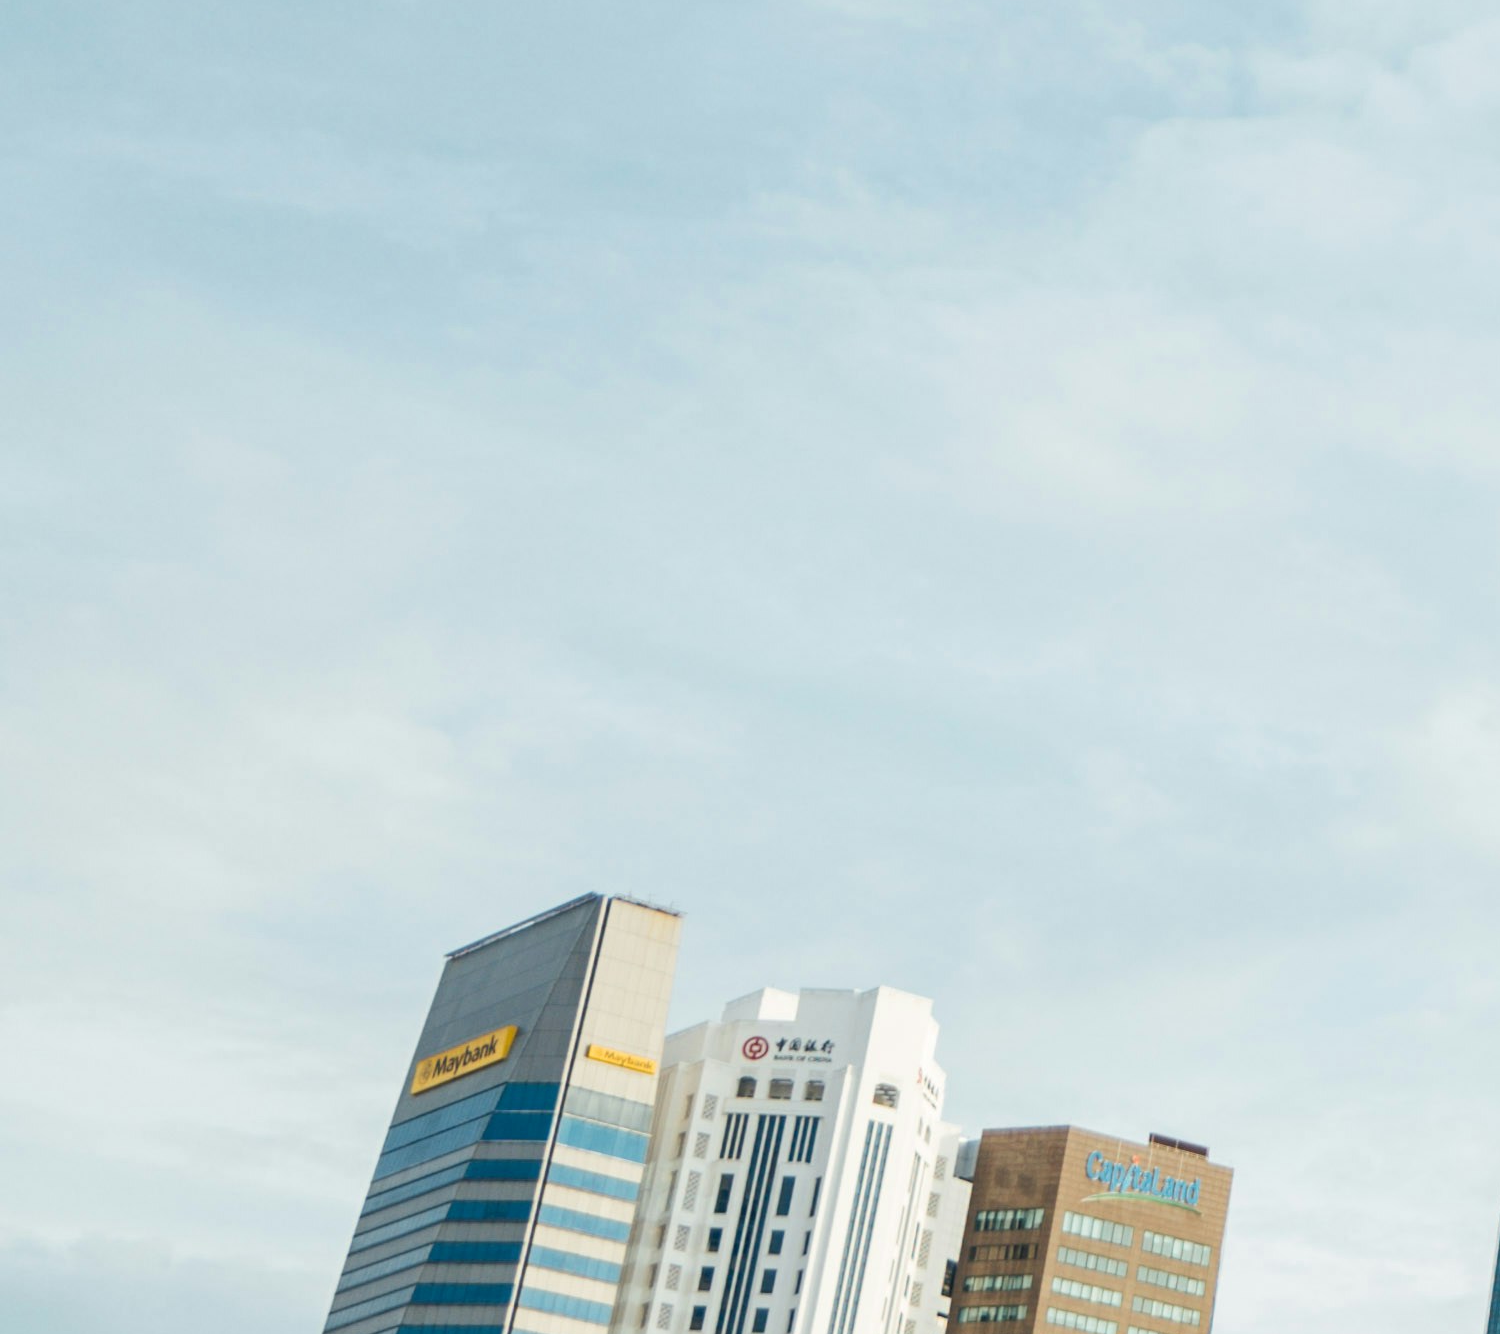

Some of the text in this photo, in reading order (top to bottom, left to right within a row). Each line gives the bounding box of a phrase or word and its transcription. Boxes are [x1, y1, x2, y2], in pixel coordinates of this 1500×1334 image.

[432, 1034, 498, 1079] Maybank
[604, 1050, 653, 1070] Maybank
[1085, 1150, 1201, 1206] CapitaLand
